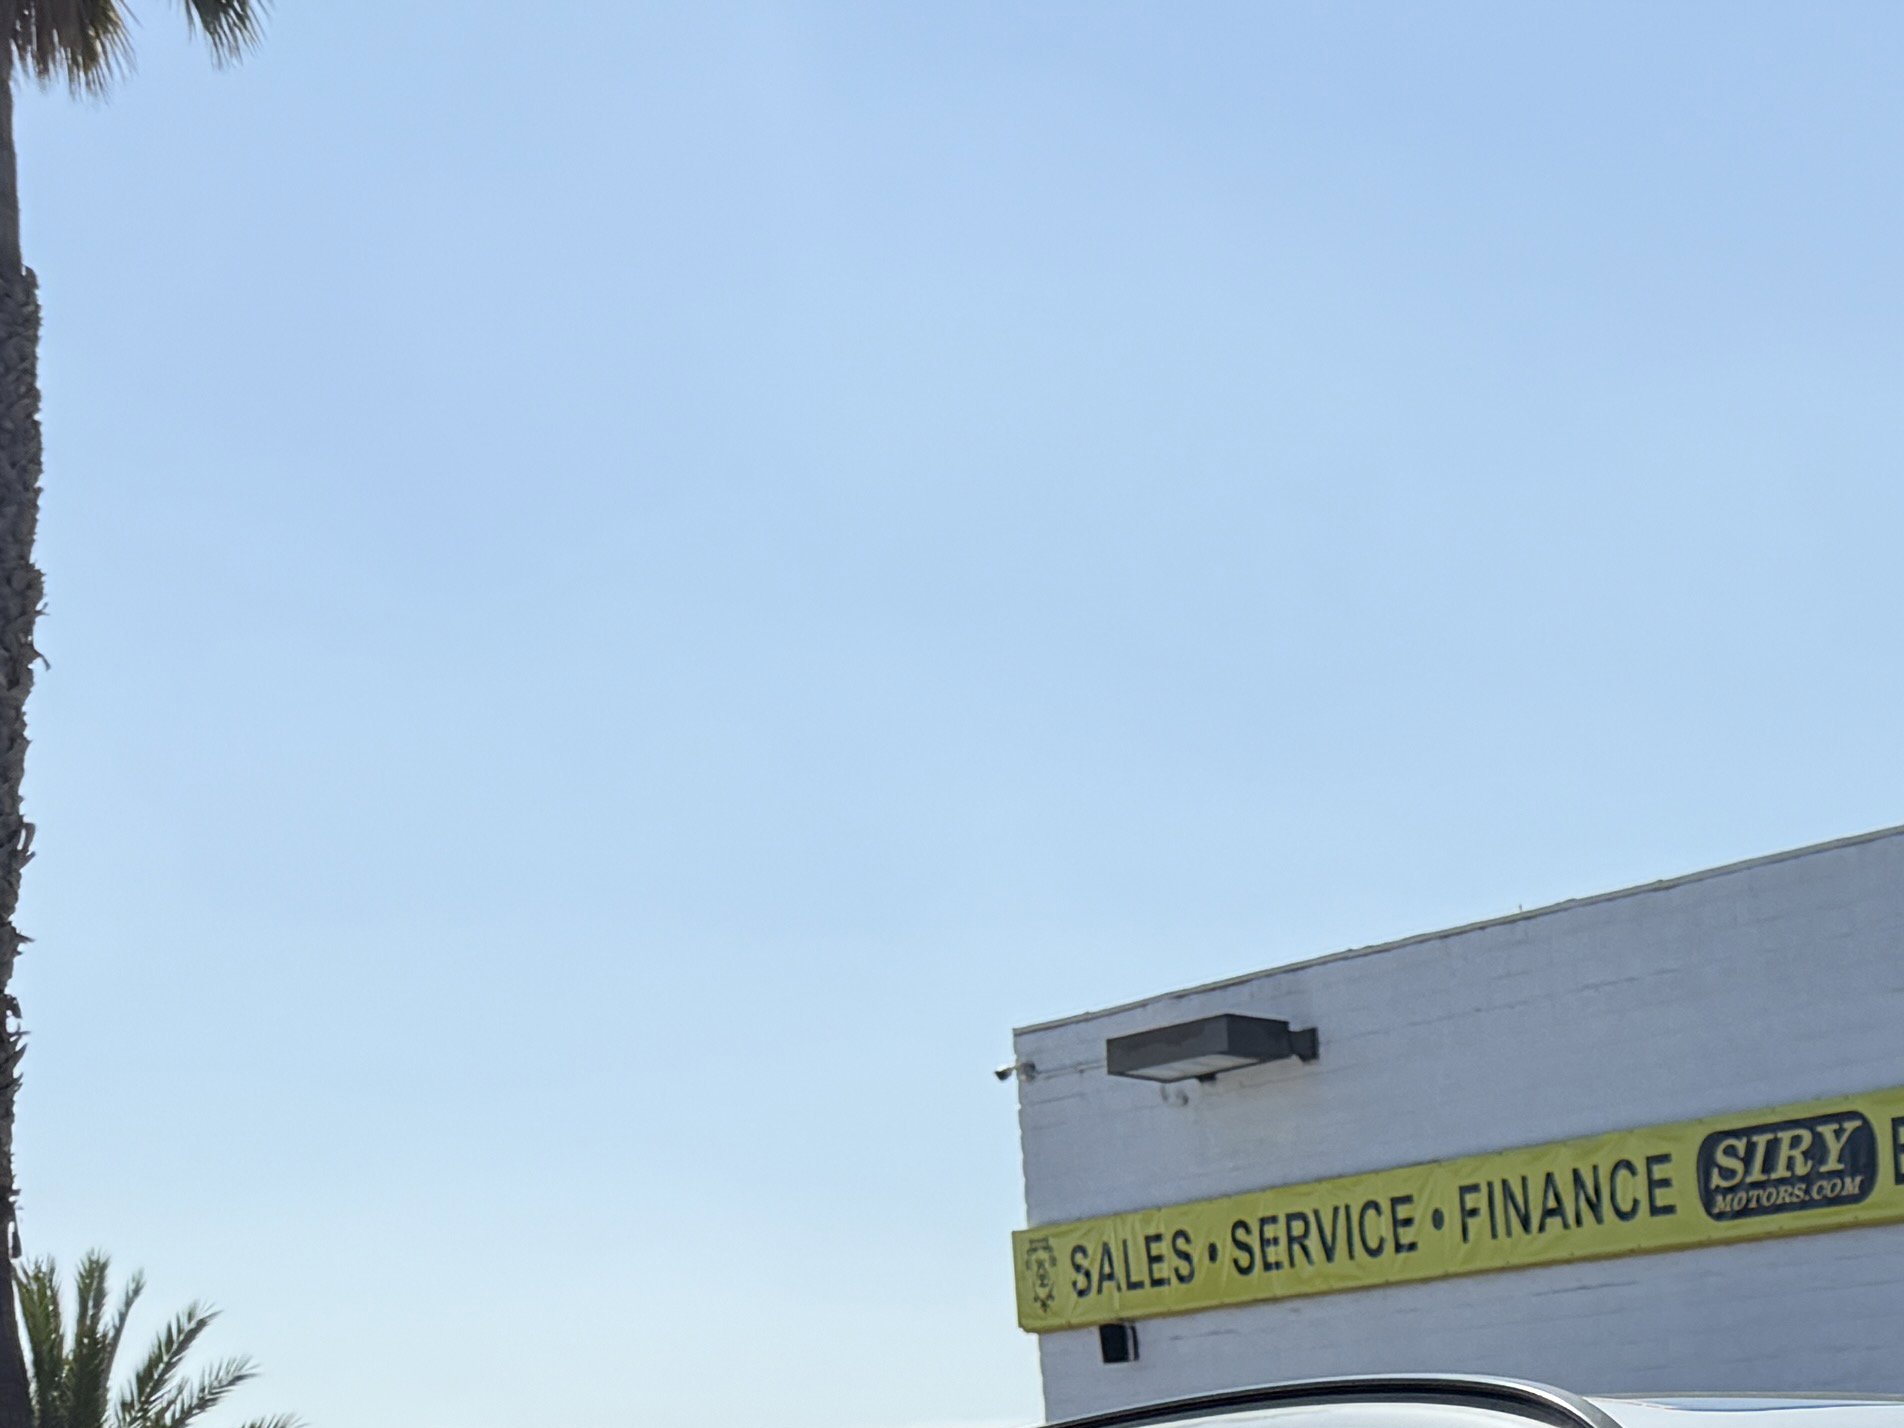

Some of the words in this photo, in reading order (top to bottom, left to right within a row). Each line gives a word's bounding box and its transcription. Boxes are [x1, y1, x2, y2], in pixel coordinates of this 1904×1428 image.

[1709, 1119, 1862, 1188] SIRY
[1070, 1228, 1195, 1298] SALES
[1232, 1194, 1418, 1275] SERVICE
[1458, 1152, 1677, 1244] FINANCE
[1714, 1175, 1862, 1213] MOTORS.COM
